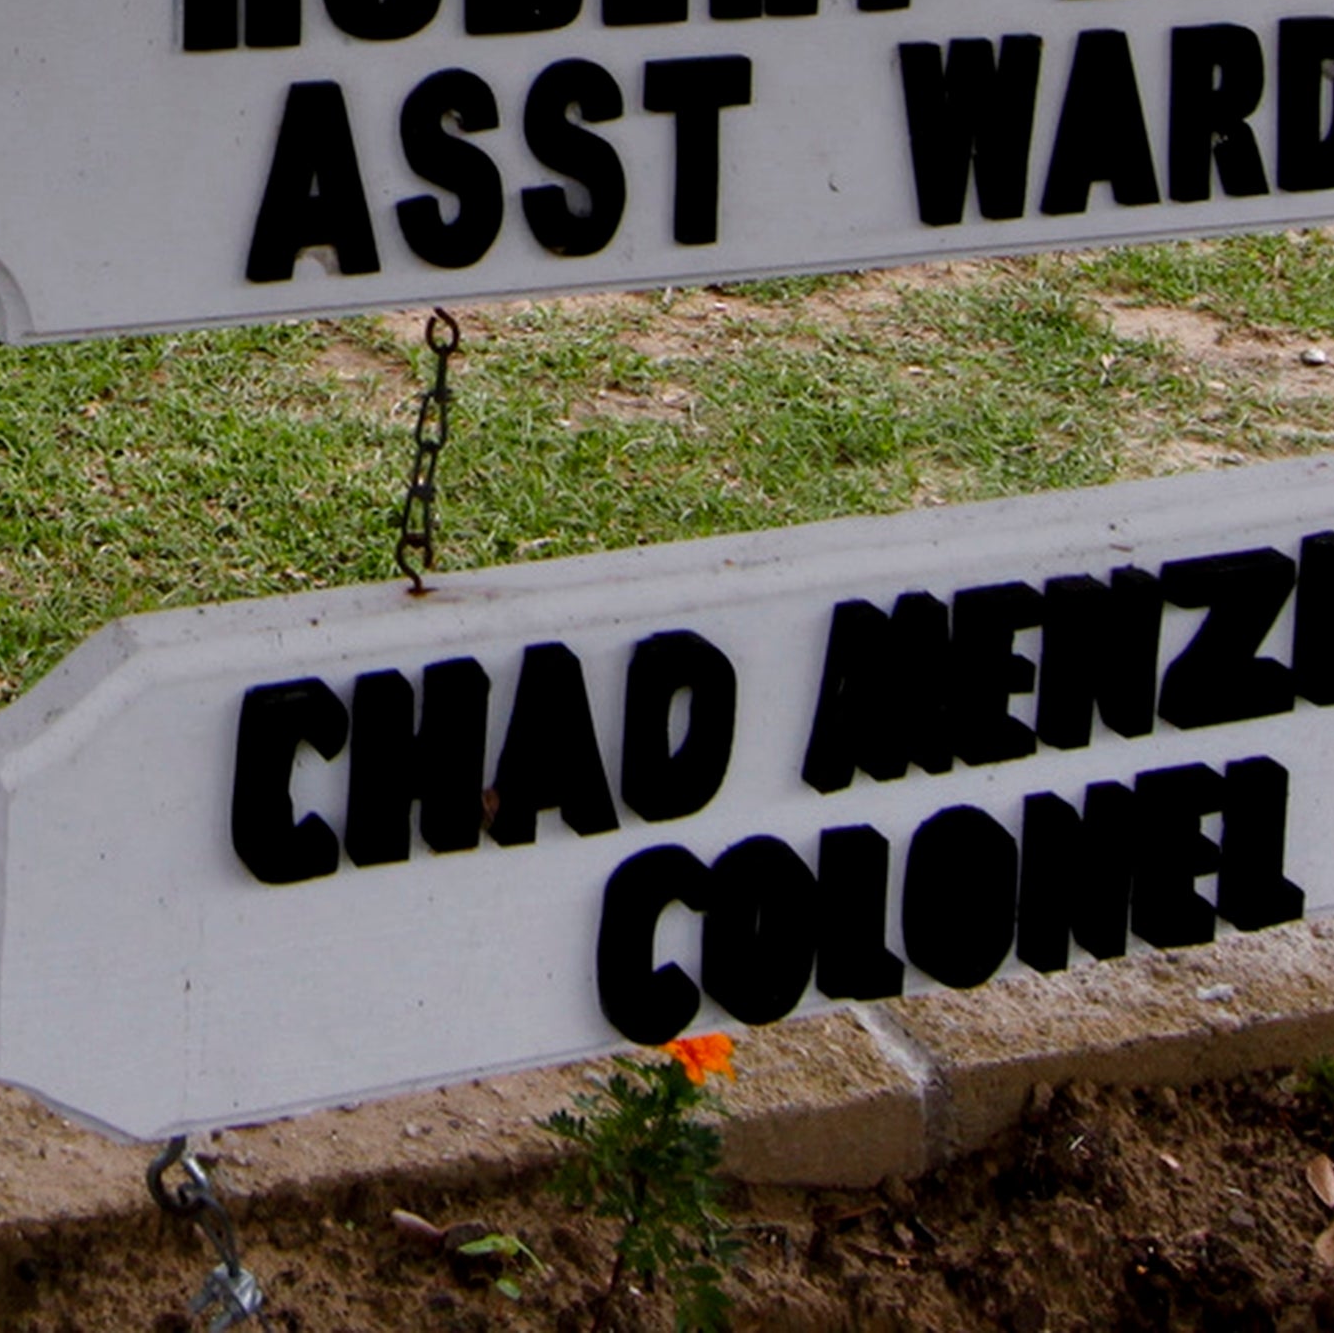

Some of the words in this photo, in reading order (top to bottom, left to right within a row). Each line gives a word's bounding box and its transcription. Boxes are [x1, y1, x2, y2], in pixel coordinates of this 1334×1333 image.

[246, 56, 751, 283] ASST
[232, 631, 736, 884] CHAD
[597, 757, 1304, 1046] COLONEL
